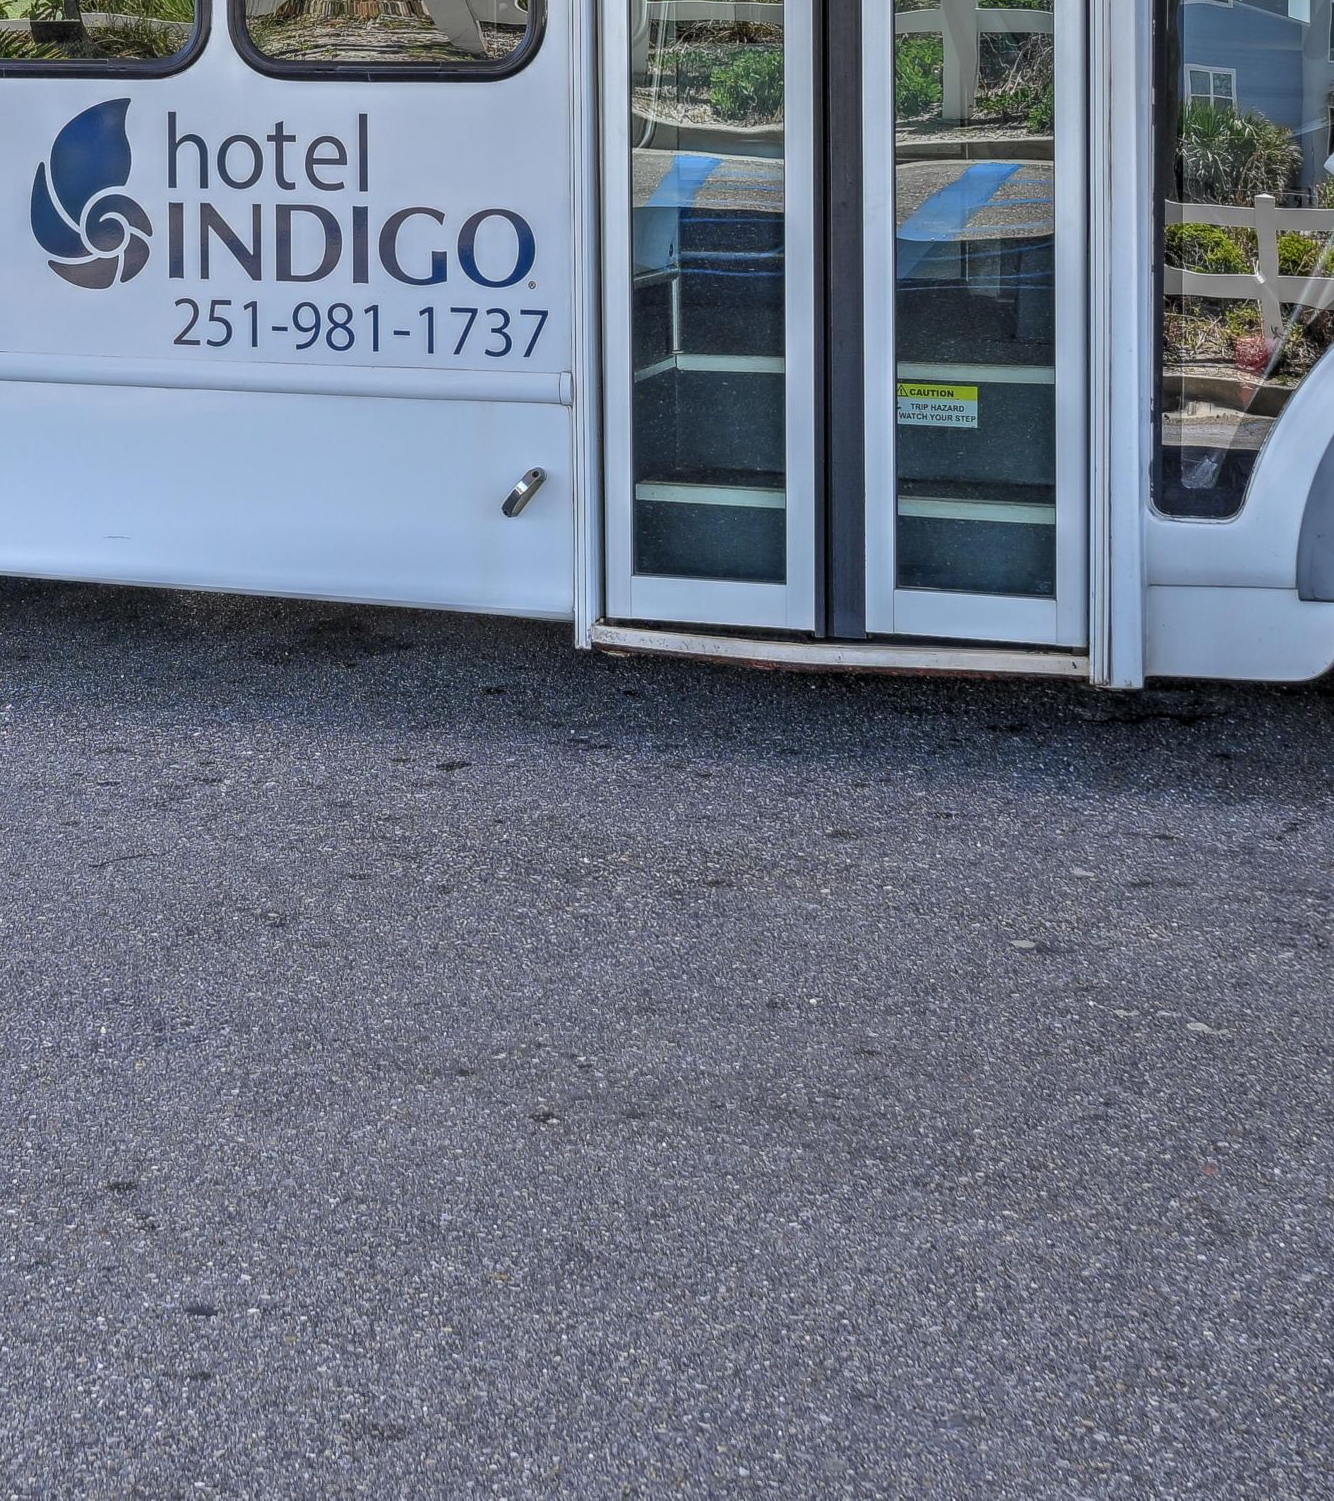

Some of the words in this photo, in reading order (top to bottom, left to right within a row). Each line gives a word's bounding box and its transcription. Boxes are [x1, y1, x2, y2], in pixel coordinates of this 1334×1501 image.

[168, 111, 368, 192] hotel
[168, 202, 536, 288] INDIGO
[173, 297, 549, 358] 251-981-1737
[909, 388, 954, 398] CAUTION
[931, 404, 965, 412] HAZARD
[899, 412, 927, 420] WATCH
[930, 414, 953, 422] YOUR
